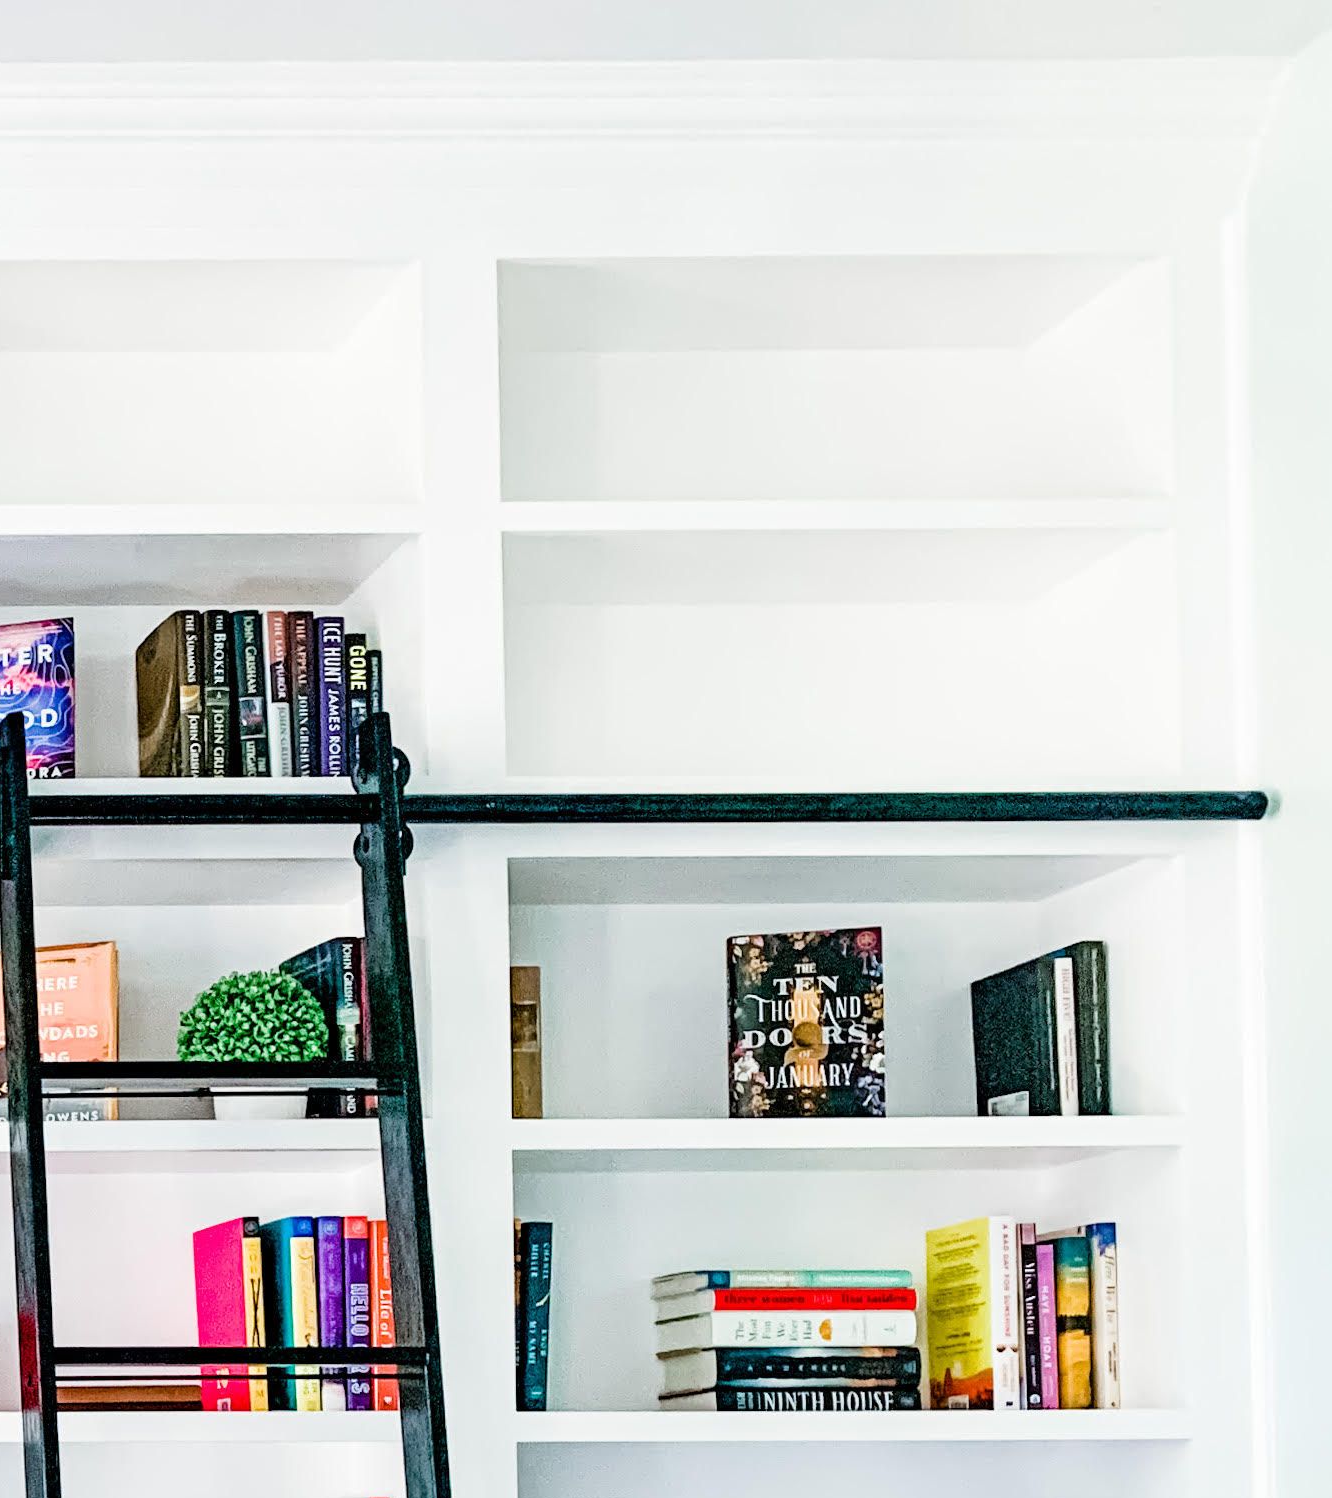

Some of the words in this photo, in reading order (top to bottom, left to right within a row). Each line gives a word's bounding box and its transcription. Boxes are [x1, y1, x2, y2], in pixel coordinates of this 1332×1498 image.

[242, 616, 256, 642] JOHN
[273, 616, 285, 636] THE
[296, 619, 307, 642] THE
[323, 622, 339, 644] ICE
[186, 635, 197, 683] SUMMONS
[213, 633, 226, 684] BROKER
[273, 639, 284, 662] LAST
[296, 645, 308, 685] APPEAL
[324, 647, 340, 682] HUNT
[244, 645, 259, 693] GRISHAM
[274, 664, 286, 698] JUROR
[349, 645, 367, 691] GONE
[296, 694, 308, 725] JOHN
[327, 688, 340, 733] JAMES
[213, 709, 226, 743] JOHN
[795, 964, 816, 975] THE
[772, 976, 839, 995] TEN
[743, 996, 861, 1023] THOUSAND
[764, 1063, 854, 1090] JANUARY
[351, 1283, 368, 1335] HELLO
[764, 1391, 825, 1411] NINTH
[832, 1390, 895, 1411] HOUSE
